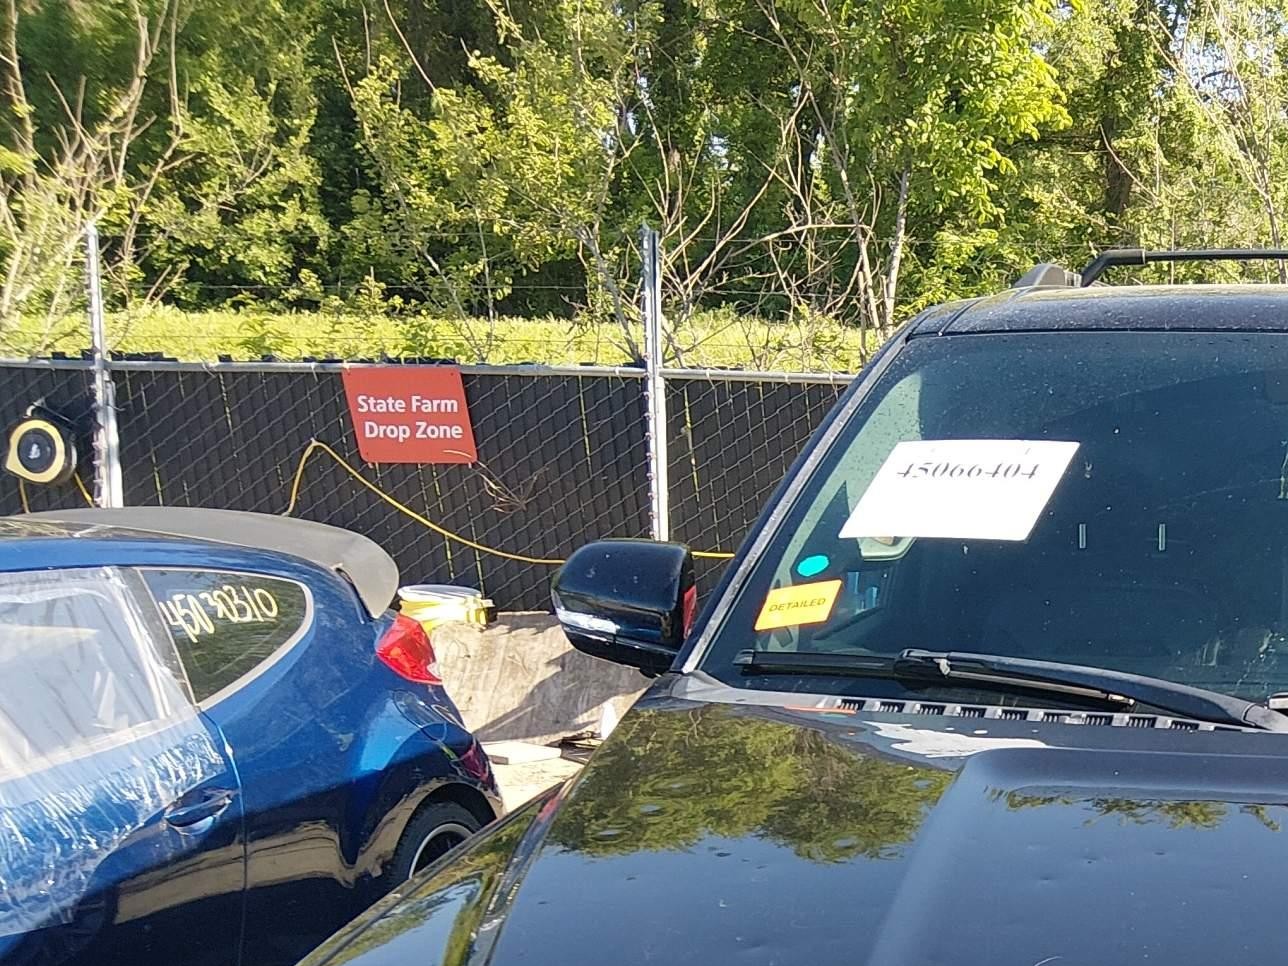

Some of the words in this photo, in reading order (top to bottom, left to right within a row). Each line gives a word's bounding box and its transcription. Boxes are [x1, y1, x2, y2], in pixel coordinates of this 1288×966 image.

[357, 395, 406, 413] State
[411, 395, 458, 413] Farm
[364, 421, 411, 443] Drop
[415, 421, 463, 439] Zone
[897, 462, 1040, 479] 45066404
[768, 597, 827, 613] DETAILED
